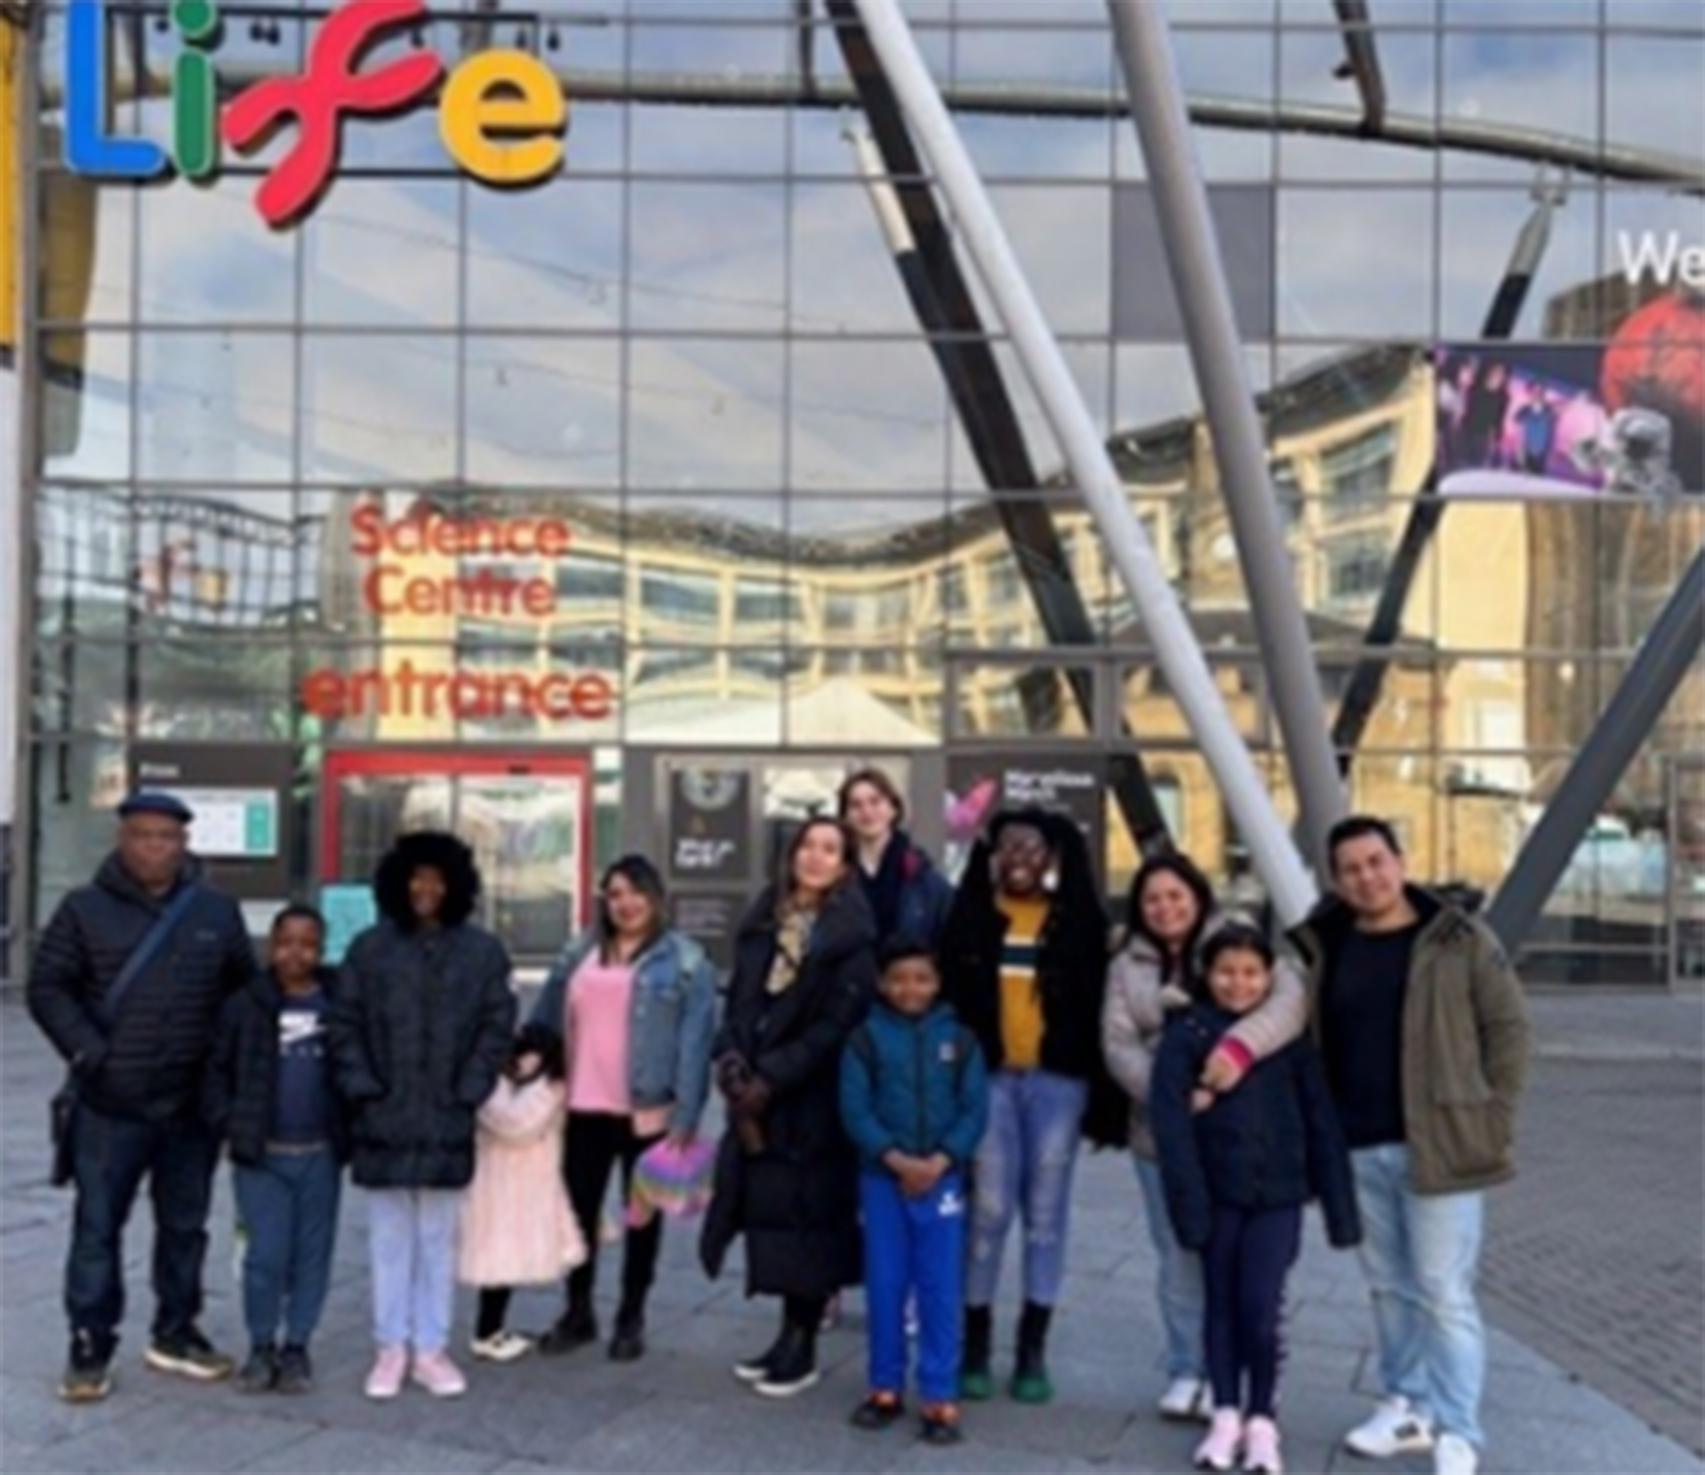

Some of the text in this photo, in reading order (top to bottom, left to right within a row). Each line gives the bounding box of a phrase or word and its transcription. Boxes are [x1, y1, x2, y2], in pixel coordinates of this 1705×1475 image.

[64, 0, 567, 222] Life
[351, 500, 570, 557] Science
[364, 564, 557, 617] Centre
[301, 658, 614, 720] entrance
